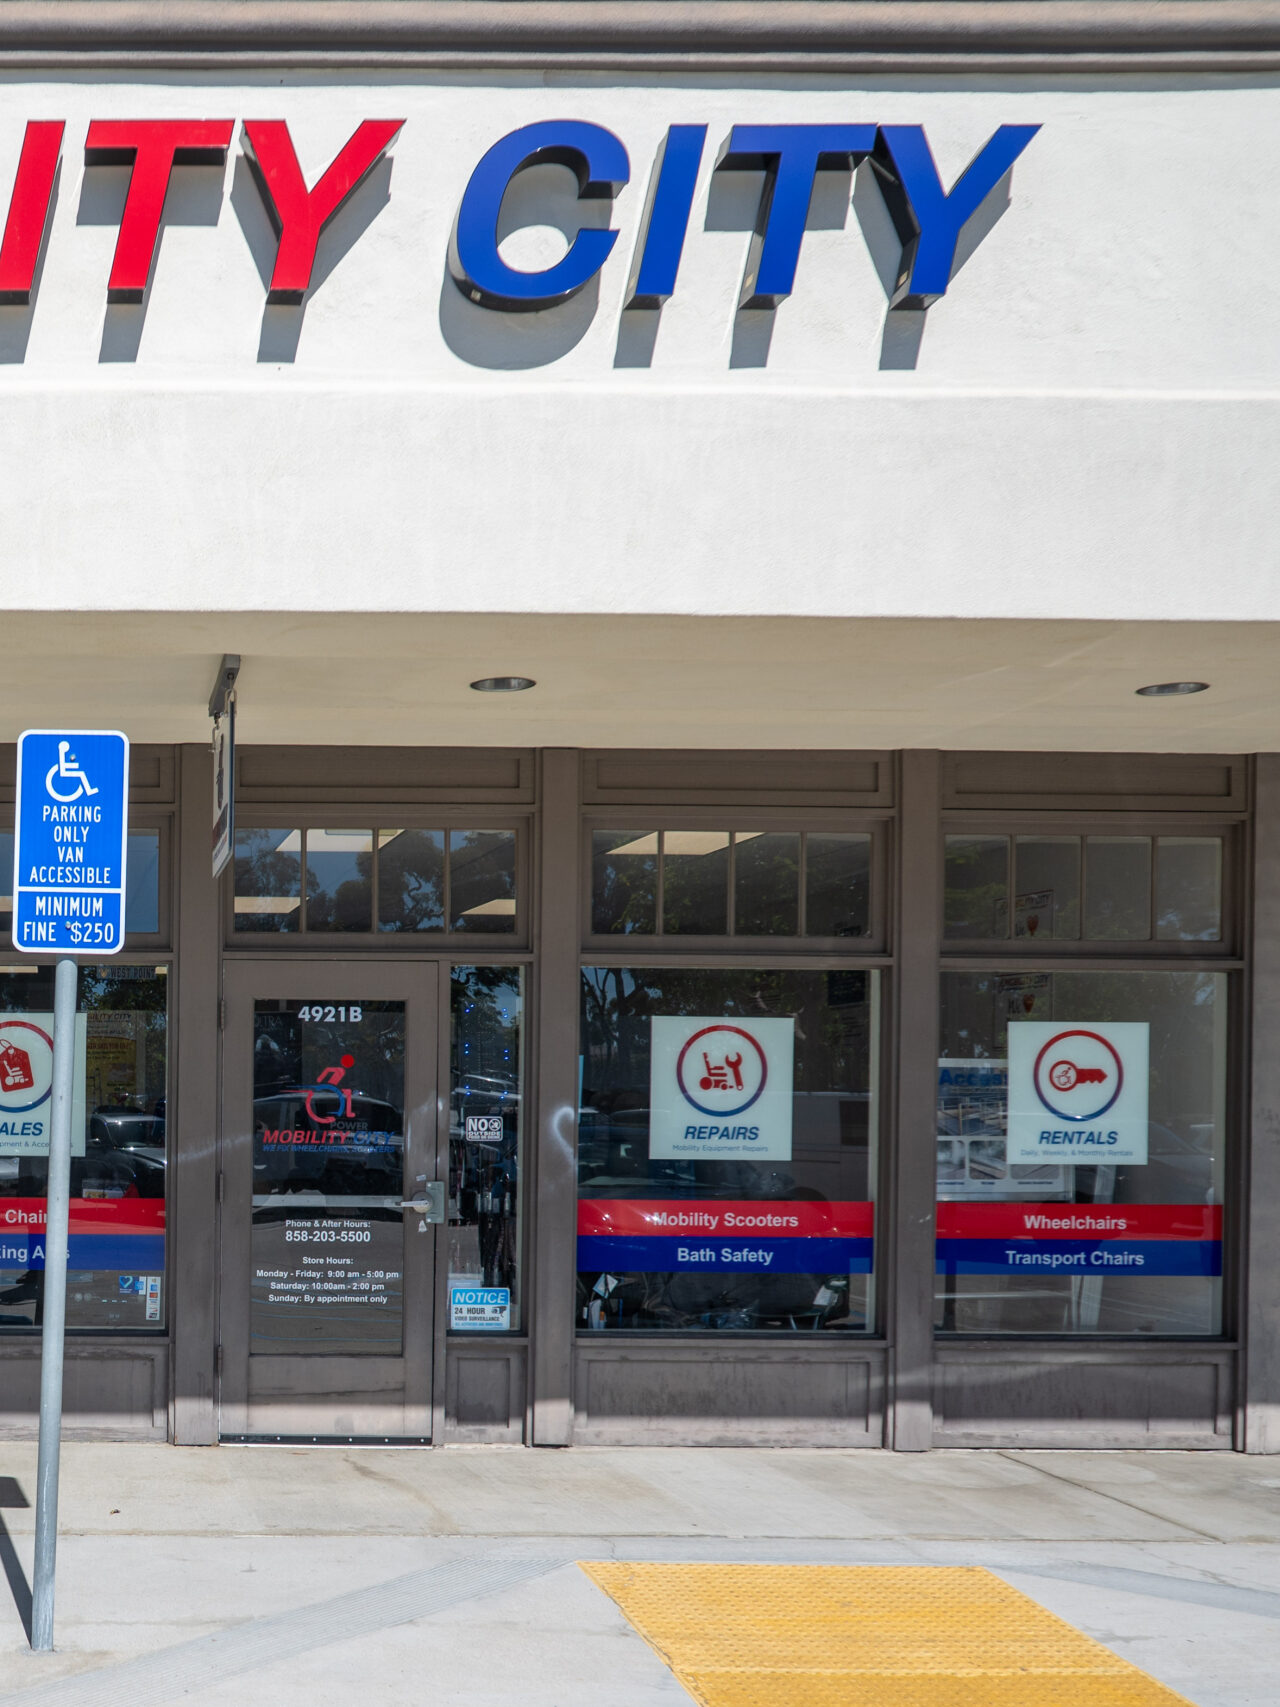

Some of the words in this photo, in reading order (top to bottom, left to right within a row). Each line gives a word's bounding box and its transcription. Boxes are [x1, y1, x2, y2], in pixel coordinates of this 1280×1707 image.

[455, 119, 1044, 303] CITY
[42, 805, 102, 823] PARKING
[53, 825, 90, 843] ONLY
[57, 846, 84, 863] VAN
[29, 866, 111, 884] ACCESSIBLE
[35, 896, 103, 917] MINIMUM
[23, 921, 57, 942] FINE
[70, 920, 114, 944] $250
[297, 1005, 363, 1023] 4921B
[468, 1118, 488, 1131] NO
[263, 1129, 351, 1144] MOBILITY
[353, 1130, 396, 1145] CITY
[684, 1126, 760, 1140] REPAIRS
[1038, 1131, 1119, 1145] RENTALS
[672, 1144, 700, 1153] Mobility
[702, 1144, 740, 1153] Equipment
[742, 1145, 768, 1153] Repairs
[285, 1220, 312, 1228] Phone
[313, 1220, 320, 1228] &
[321, 1220, 341, 1228] After
[343, 1220, 371, 1228] Hours:
[653, 1212, 719, 1230] Mobility
[723, 1212, 799, 1228] Scooters
[1023, 1215, 1128, 1230] Wheelchairs
[285, 1230, 371, 1242] 858-203-5500
[302, 1256, 325, 1265] Store
[326, 1256, 354, 1265] Hours:
[677, 1247, 716, 1263] Bath
[720, 1247, 774, 1266] Safety
[1004, 1250, 1086, 1269] Transport
[1090, 1251, 1145, 1266] Chairs
[256, 1270, 288, 1279] Monday
[295, 1270, 324, 1279] Friday:
[327, 1270, 345, 1278] 9:00
[366, 1271, 384, 1279] 5:00
[386, 1272, 399, 1280] pm
[270, 1282, 309, 1291] Saturday:
[311, 1282, 346, 1290] 10:00am
[371, 1284, 385, 1292] pm
[268, 1294, 302, 1303] Sunday:
[304, 1295, 315, 1303] By
[317, 1295, 368, 1304] appointment
[370, 1295, 388, 1304] only
[455, 1292, 507, 1304] NOTICE
[454, 1307, 463, 1315] 24
[466, 1307, 486, 1315] HOUR
